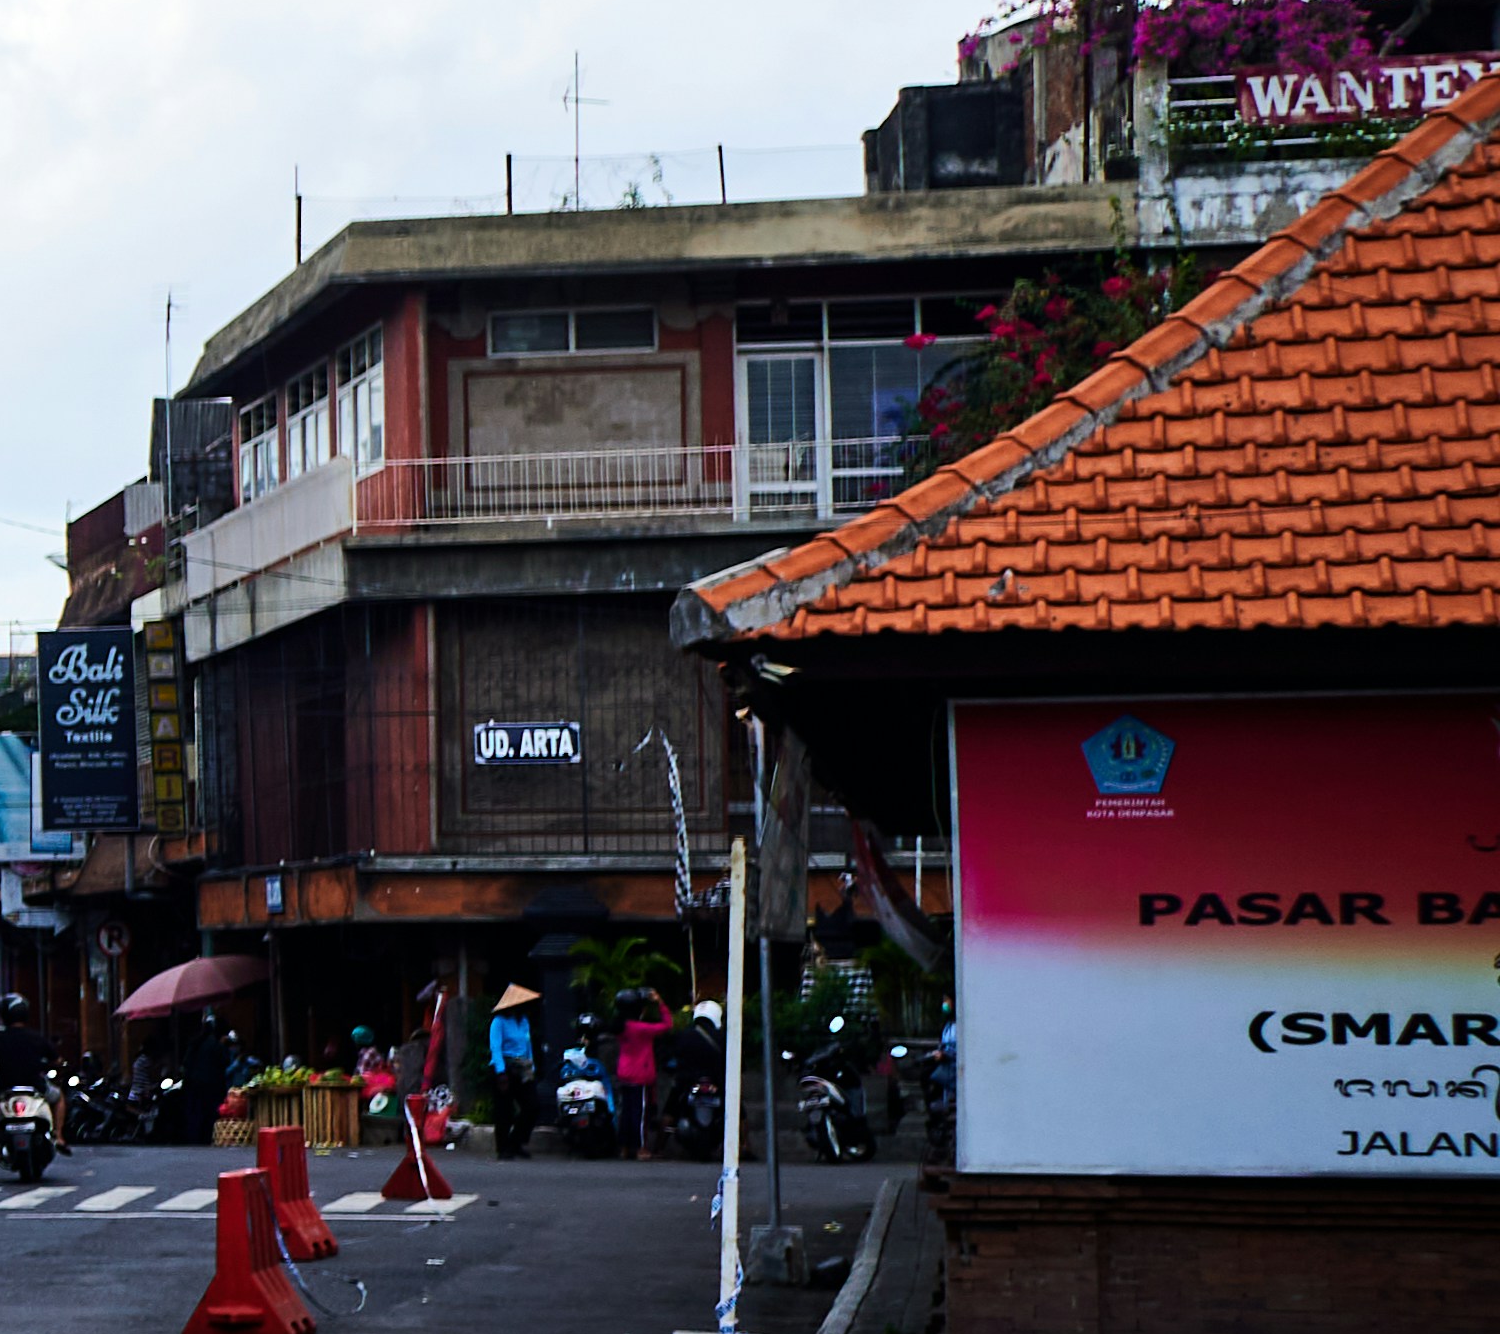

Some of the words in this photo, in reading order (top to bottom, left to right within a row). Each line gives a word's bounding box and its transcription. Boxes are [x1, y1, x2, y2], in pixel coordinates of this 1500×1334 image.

[49, 642, 124, 685] Bali
[55, 687, 121, 726] Silk
[480, 729, 515, 758] UD.
[519, 728, 574, 757] ARTA
[1117, 808, 1175, 817] DENPASAR
[1139, 892, 1391, 926] PASAR
[1249, 1011, 1500, 1053] (SMAR
[1336, 1131, 1498, 1157] JALAN
